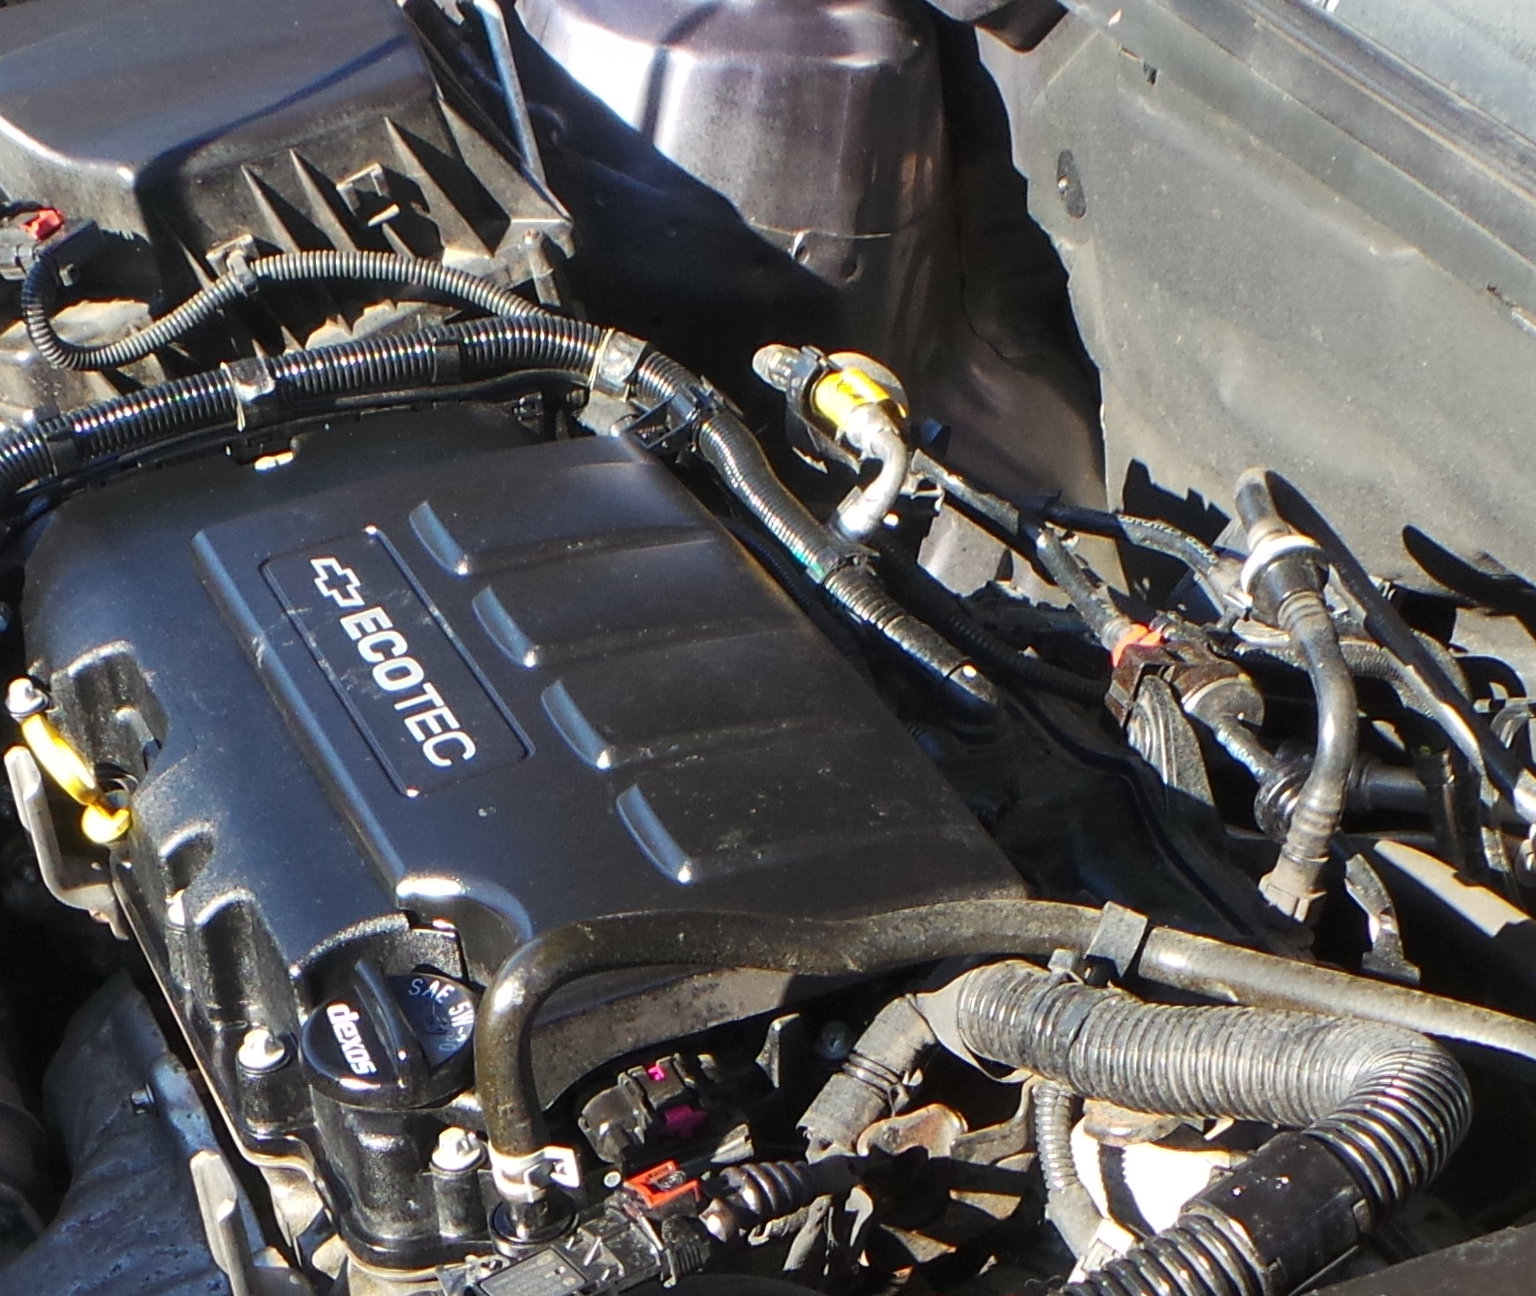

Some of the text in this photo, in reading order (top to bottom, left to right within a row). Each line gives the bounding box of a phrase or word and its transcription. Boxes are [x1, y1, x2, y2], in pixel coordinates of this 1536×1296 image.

[339, 606, 478, 769] ECOTEC
[408, 977, 455, 1004] SAE
[326, 1002, 378, 1076] dexos
